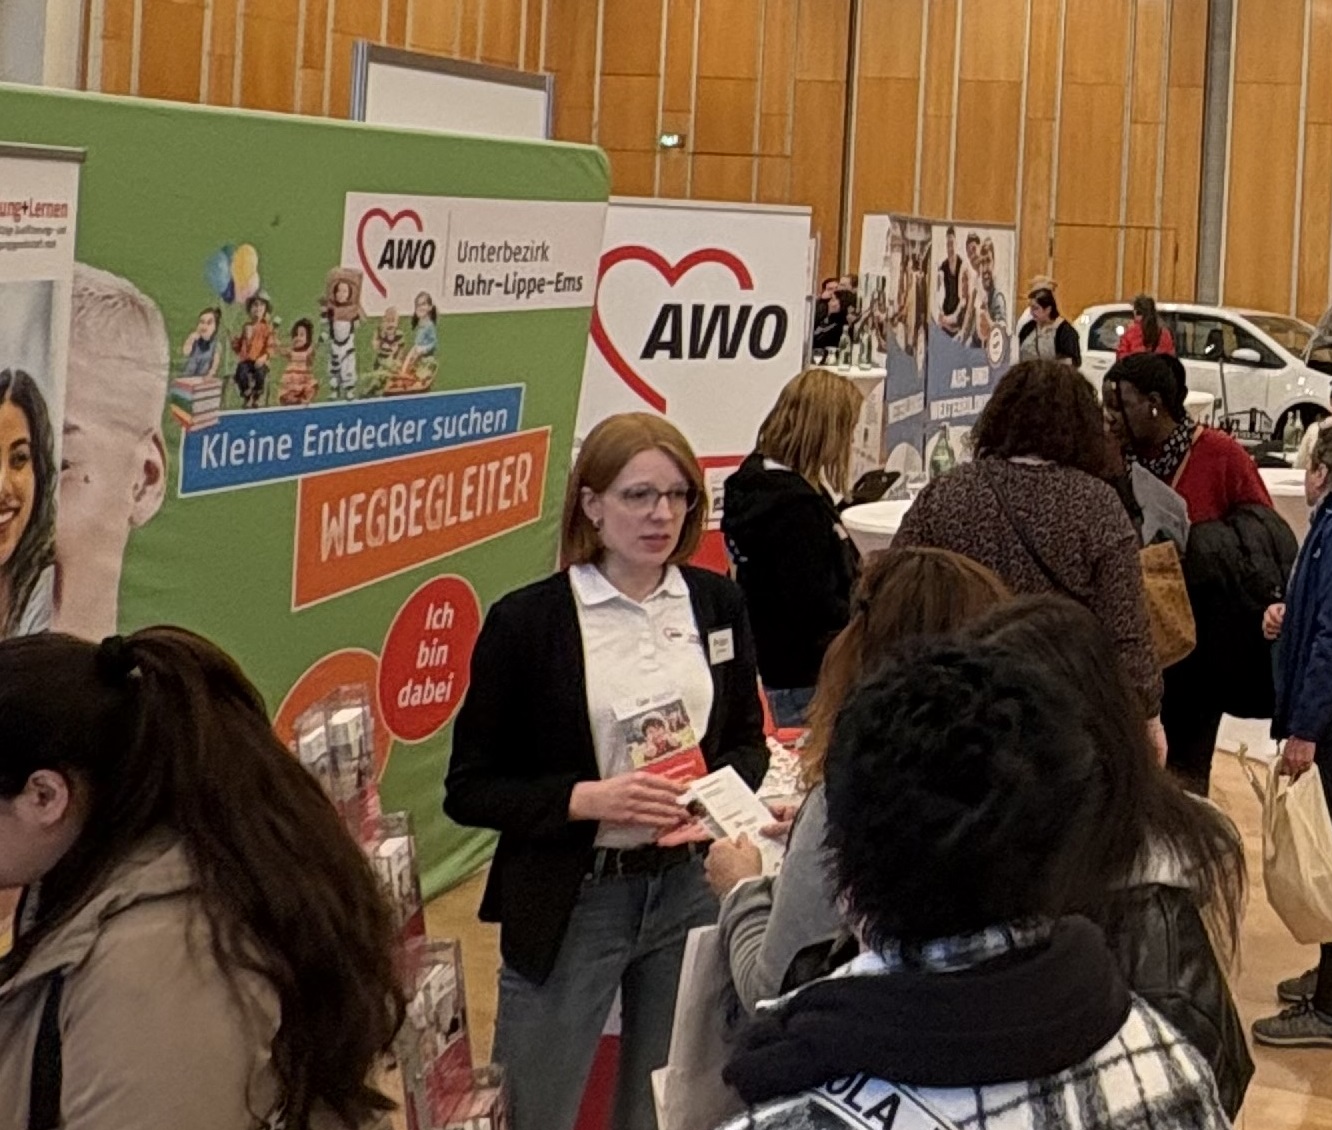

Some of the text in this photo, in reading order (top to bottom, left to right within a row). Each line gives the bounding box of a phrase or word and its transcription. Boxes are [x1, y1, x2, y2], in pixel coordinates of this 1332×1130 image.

[377, 239, 436, 270] AWO
[457, 240, 550, 263] Unterbezirk
[453, 271, 583, 300] Ruhr-Lippe-Ems
[639, 303, 788, 360] AWO
[200, 406, 508, 469] Kleine Entdecker suchen
[320, 452, 533, 563] WEGBEGLEITER
[424, 602, 455, 631] Ich
[416, 638, 448, 669] bin
[397, 672, 454, 708] dabei
